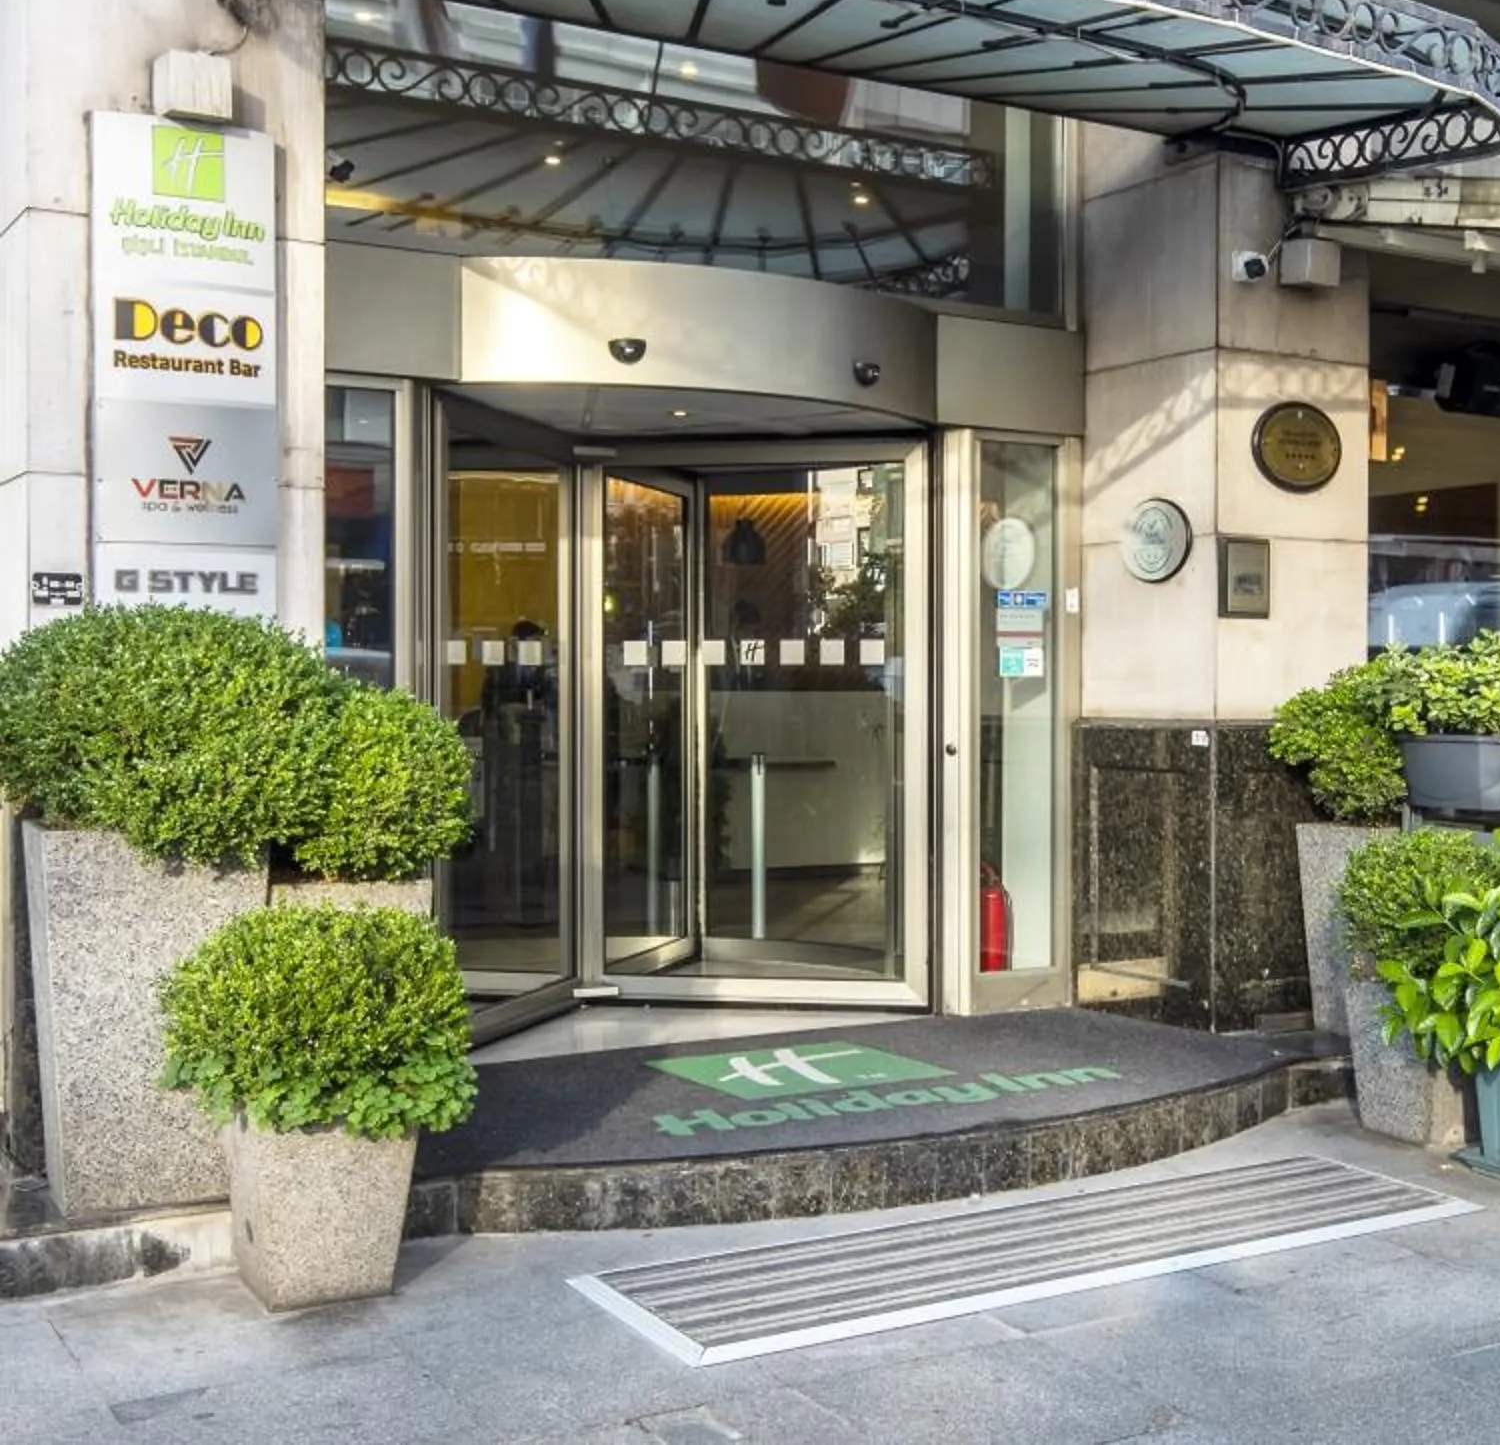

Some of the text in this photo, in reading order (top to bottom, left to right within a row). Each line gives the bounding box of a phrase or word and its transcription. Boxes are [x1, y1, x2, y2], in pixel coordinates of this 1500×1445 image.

[109, 198, 266, 242] Holiday Inn
[114, 298, 264, 351] Deco
[113, 350, 261, 378] Restaurant Bar
[131, 478, 246, 503] VERNA
[114, 569, 259, 596] G STYLE
[652, 1066, 1122, 1137] Holiday Inn
